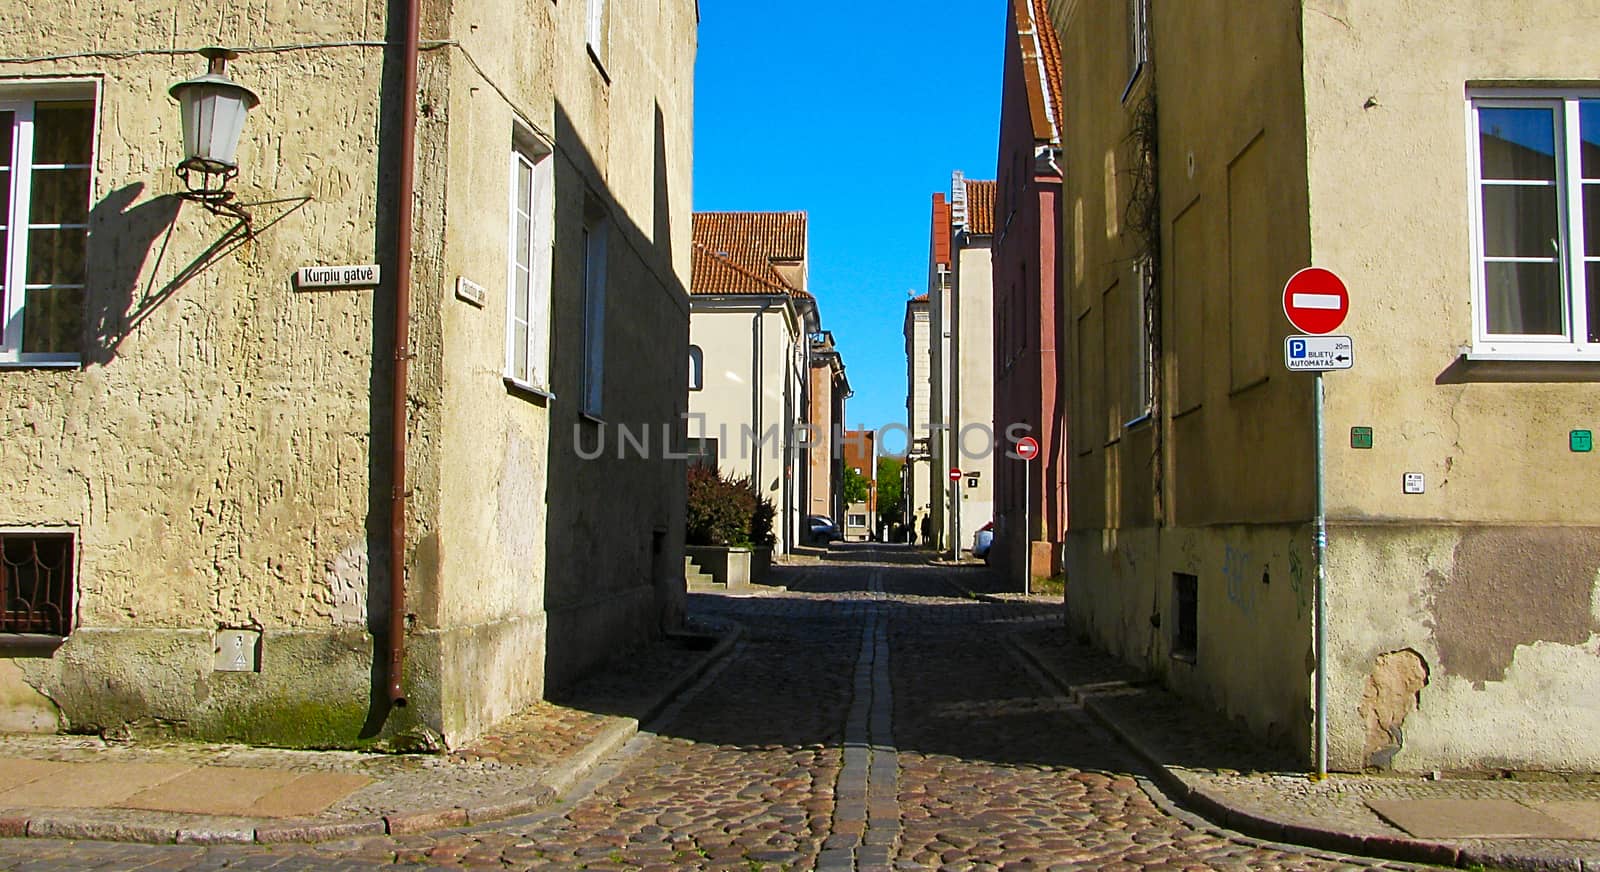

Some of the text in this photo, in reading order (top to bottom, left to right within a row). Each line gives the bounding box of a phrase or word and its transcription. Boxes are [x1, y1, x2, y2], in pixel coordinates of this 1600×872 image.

[305, 267, 373, 284] Kurpių gatvė
[1293, 342, 1304, 356] P
[1290, 359, 1334, 367] AUTOMATAS
